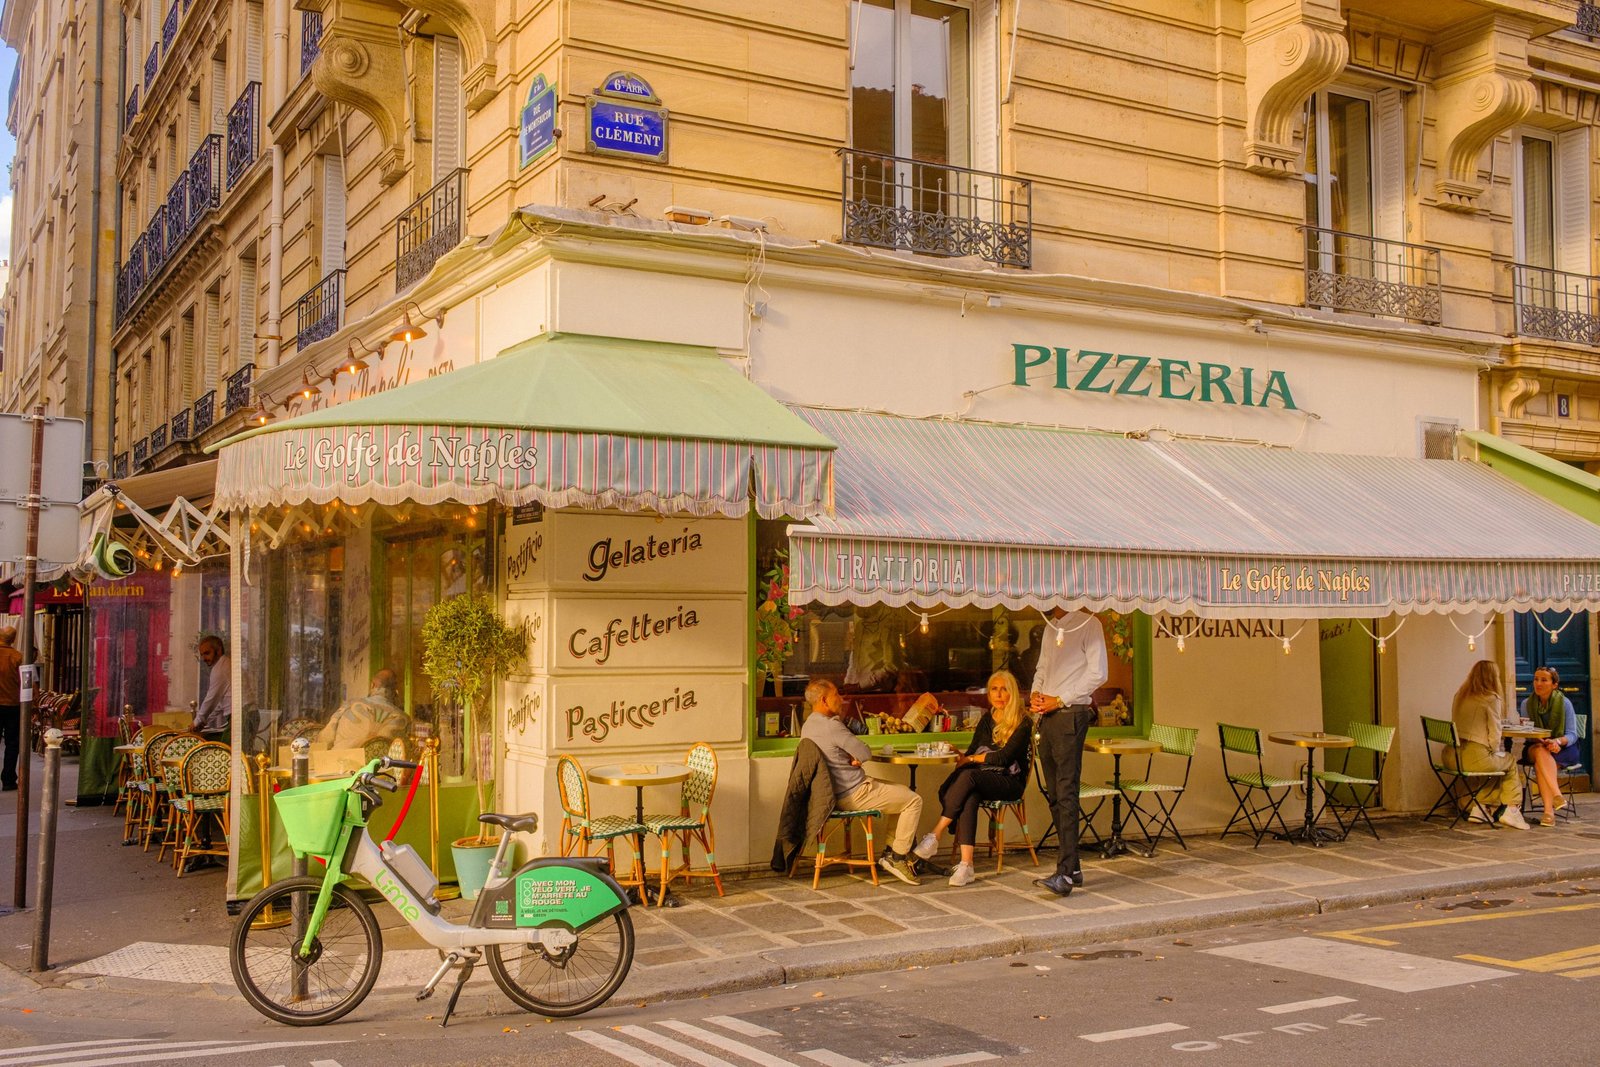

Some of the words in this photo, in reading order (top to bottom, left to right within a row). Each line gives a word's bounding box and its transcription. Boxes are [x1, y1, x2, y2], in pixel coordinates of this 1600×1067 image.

[595, 126, 661, 147] CLÉMENT
[615, 111, 644, 127] RUE
[1011, 344, 1298, 409] PIZZERIA
[1561, 399, 1568, 415] 8
[284, 440, 307, 470] Le
[314, 432, 380, 481] Golfe
[388, 431, 422, 466] de
[429, 434, 538, 481] Naples
[507, 531, 543, 580] Pastificio
[837, 554, 965, 584] TRATTORIA
[75, 582, 144, 597] Mandarin
[1221, 569, 1242, 591] Le
[1246, 565, 1291, 600] Golfe
[1296, 566, 1315, 592] de
[1318, 567, 1370, 601] Naples
[568, 606, 700, 665] Cafetteria
[507, 691, 541, 735] Panificio
[566, 687, 698, 743] Pasticceria
